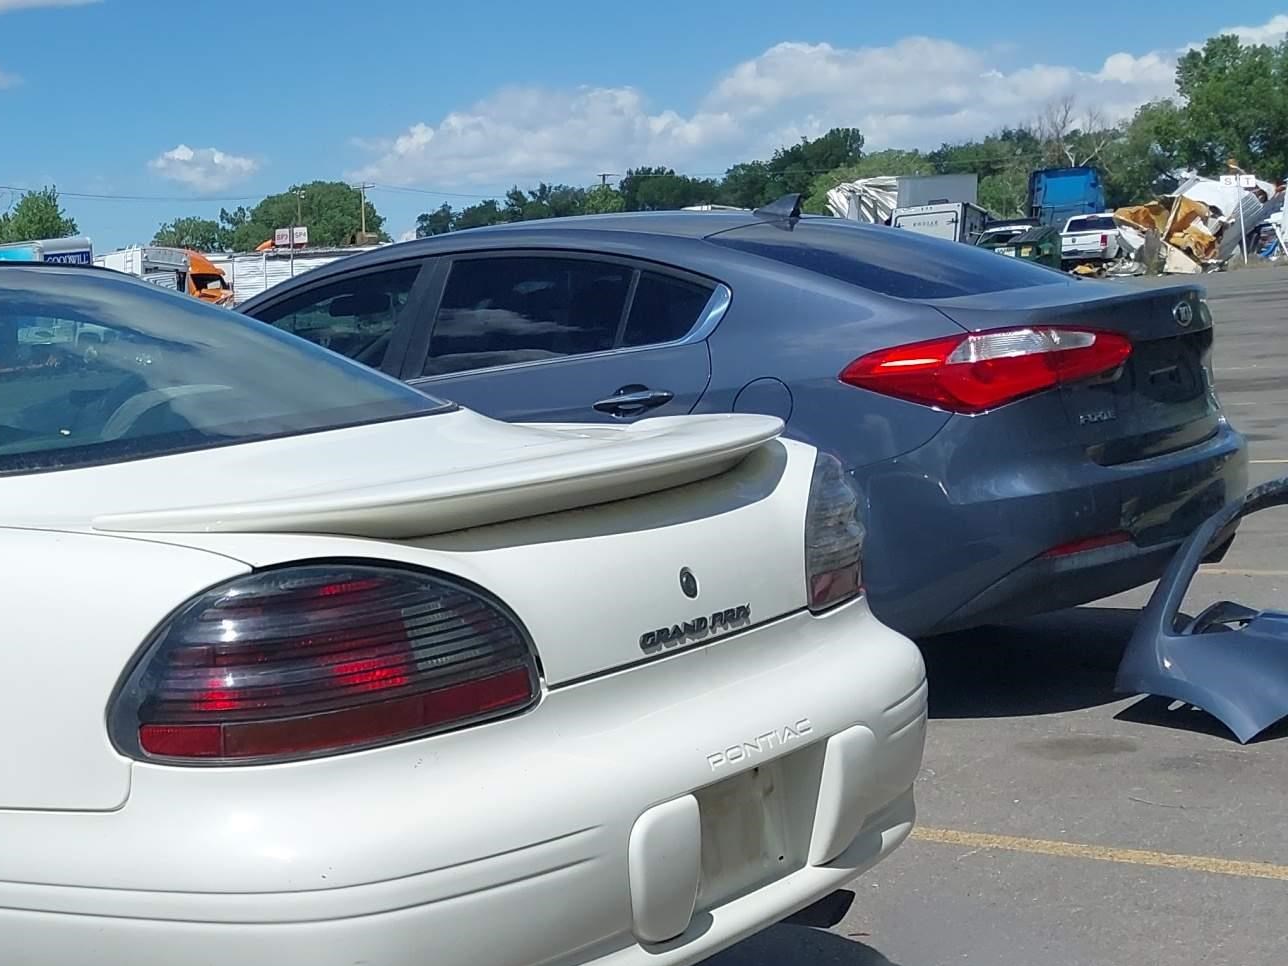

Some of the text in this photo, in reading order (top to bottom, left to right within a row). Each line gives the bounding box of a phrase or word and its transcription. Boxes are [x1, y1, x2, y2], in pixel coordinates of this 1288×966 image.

[640, 603, 752, 653] GRAND PRIX
[705, 717, 814, 772] PONTIAC
